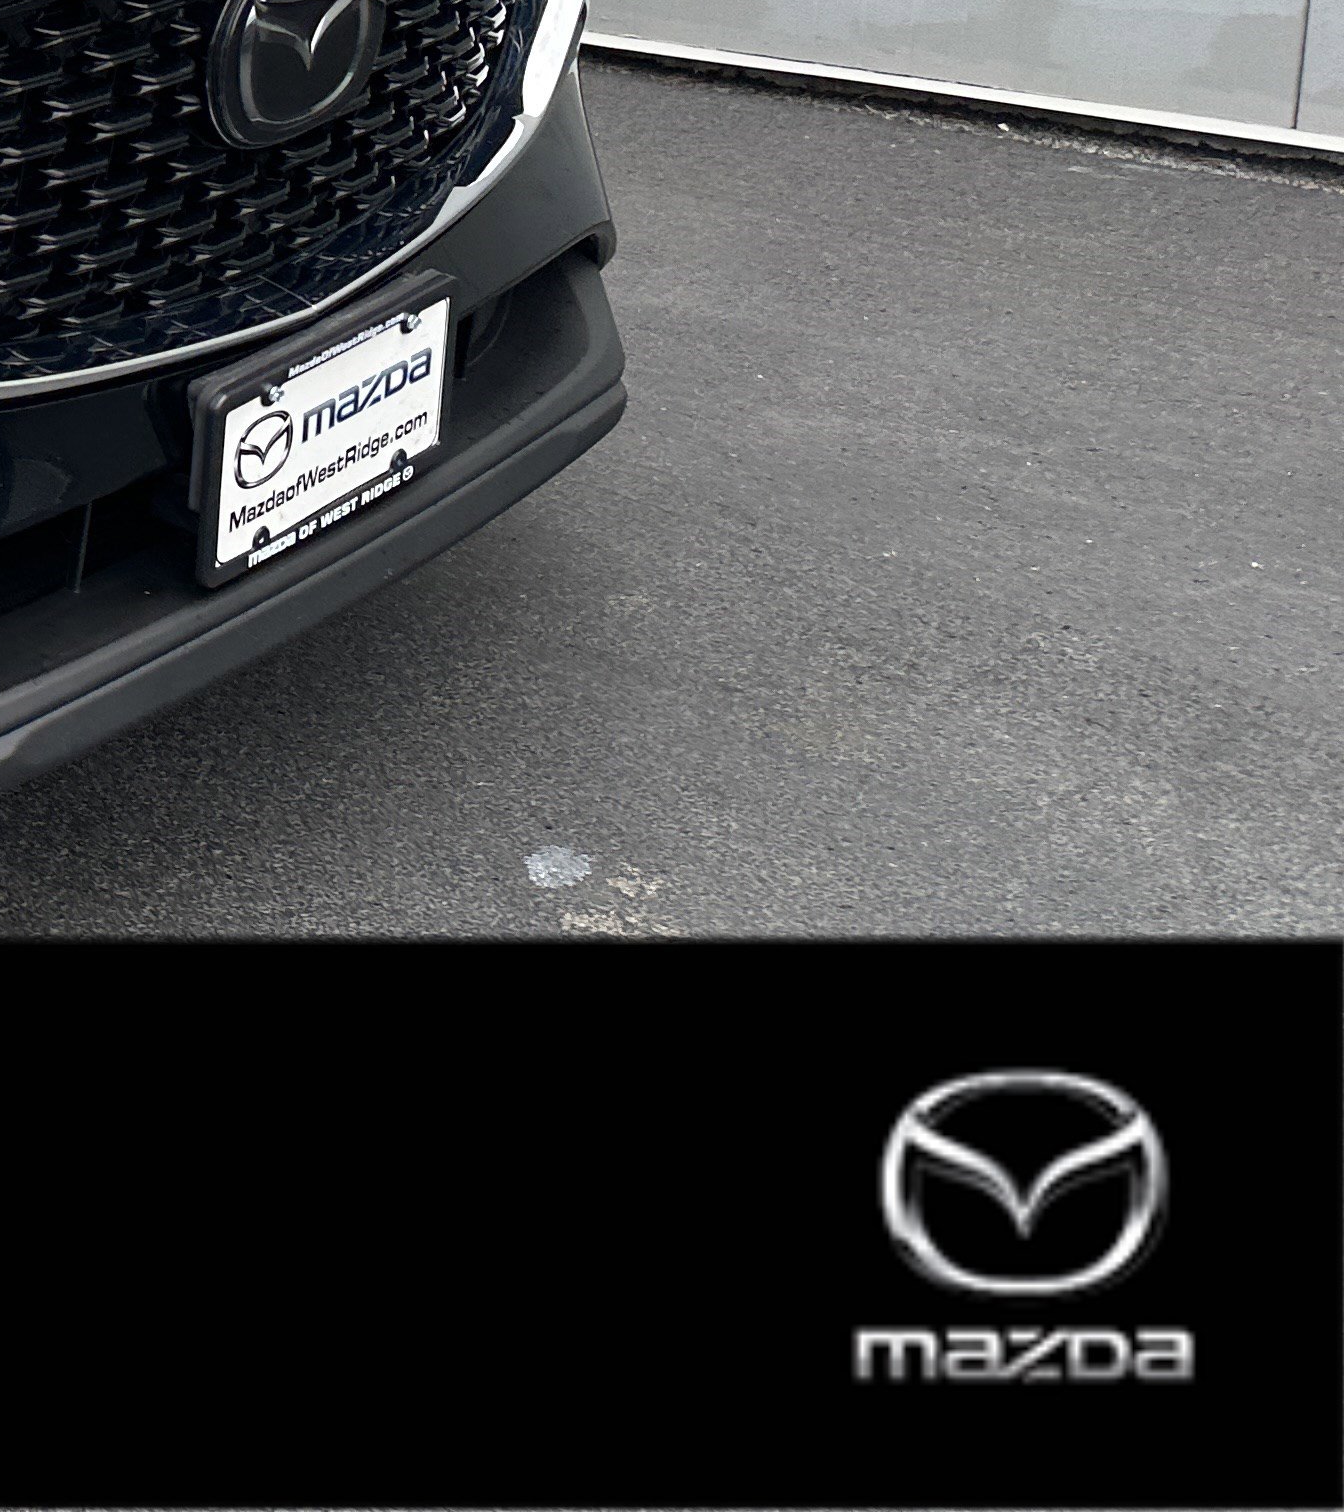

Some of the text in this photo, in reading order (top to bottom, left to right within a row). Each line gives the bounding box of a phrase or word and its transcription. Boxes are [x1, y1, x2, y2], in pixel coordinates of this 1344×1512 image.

[301, 346, 433, 444] mazda
[228, 410, 428, 533] MazdaofWestRidge.com
[298, 518, 318, 540] OF
[320, 496, 359, 531] WEST
[360, 471, 402, 506] RIDGE
